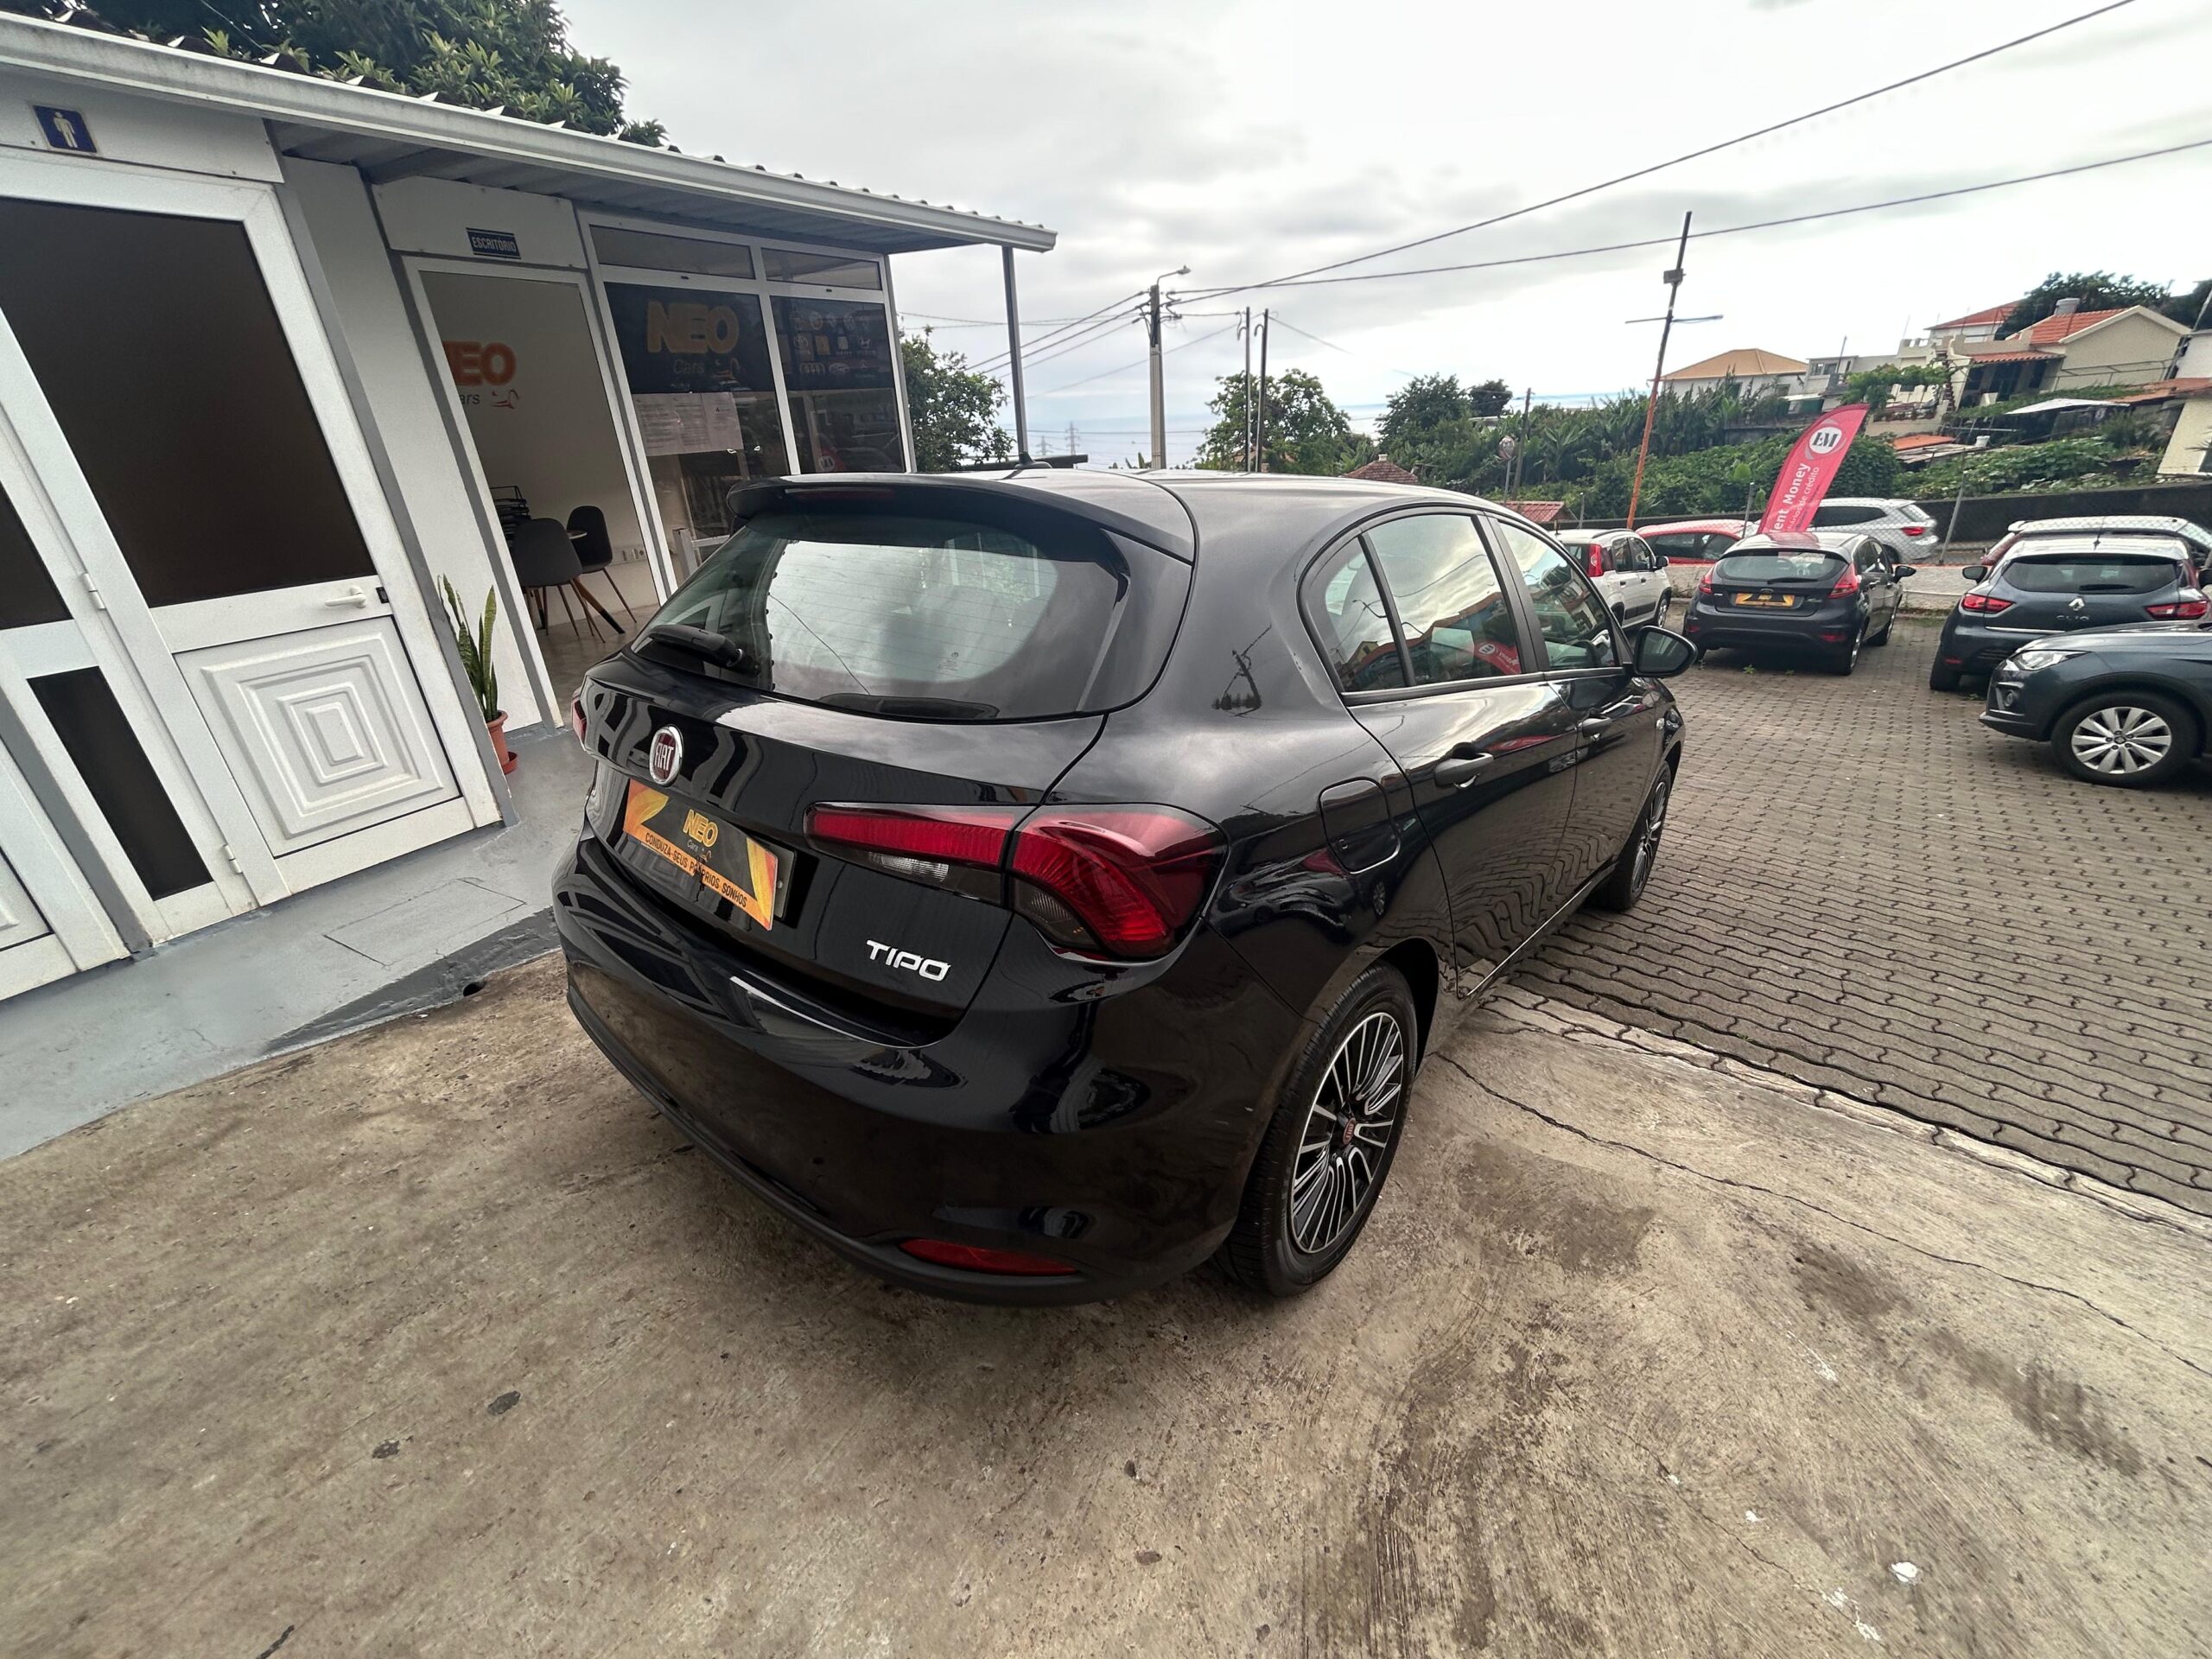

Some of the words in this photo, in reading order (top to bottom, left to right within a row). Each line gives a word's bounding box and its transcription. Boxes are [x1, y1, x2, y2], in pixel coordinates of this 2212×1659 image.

[472, 237, 517, 252] ESCRITÓRIO
[647, 300, 740, 354] NEO
[674, 359, 704, 374] Cars
[1783, 463, 1811, 505] Money
[654, 743, 674, 771] FIAT
[683, 809, 719, 848] NEO
[687, 839, 698, 852] Cars
[721, 882, 747, 907] SONHOS
[866, 939, 951, 982] TIPO
